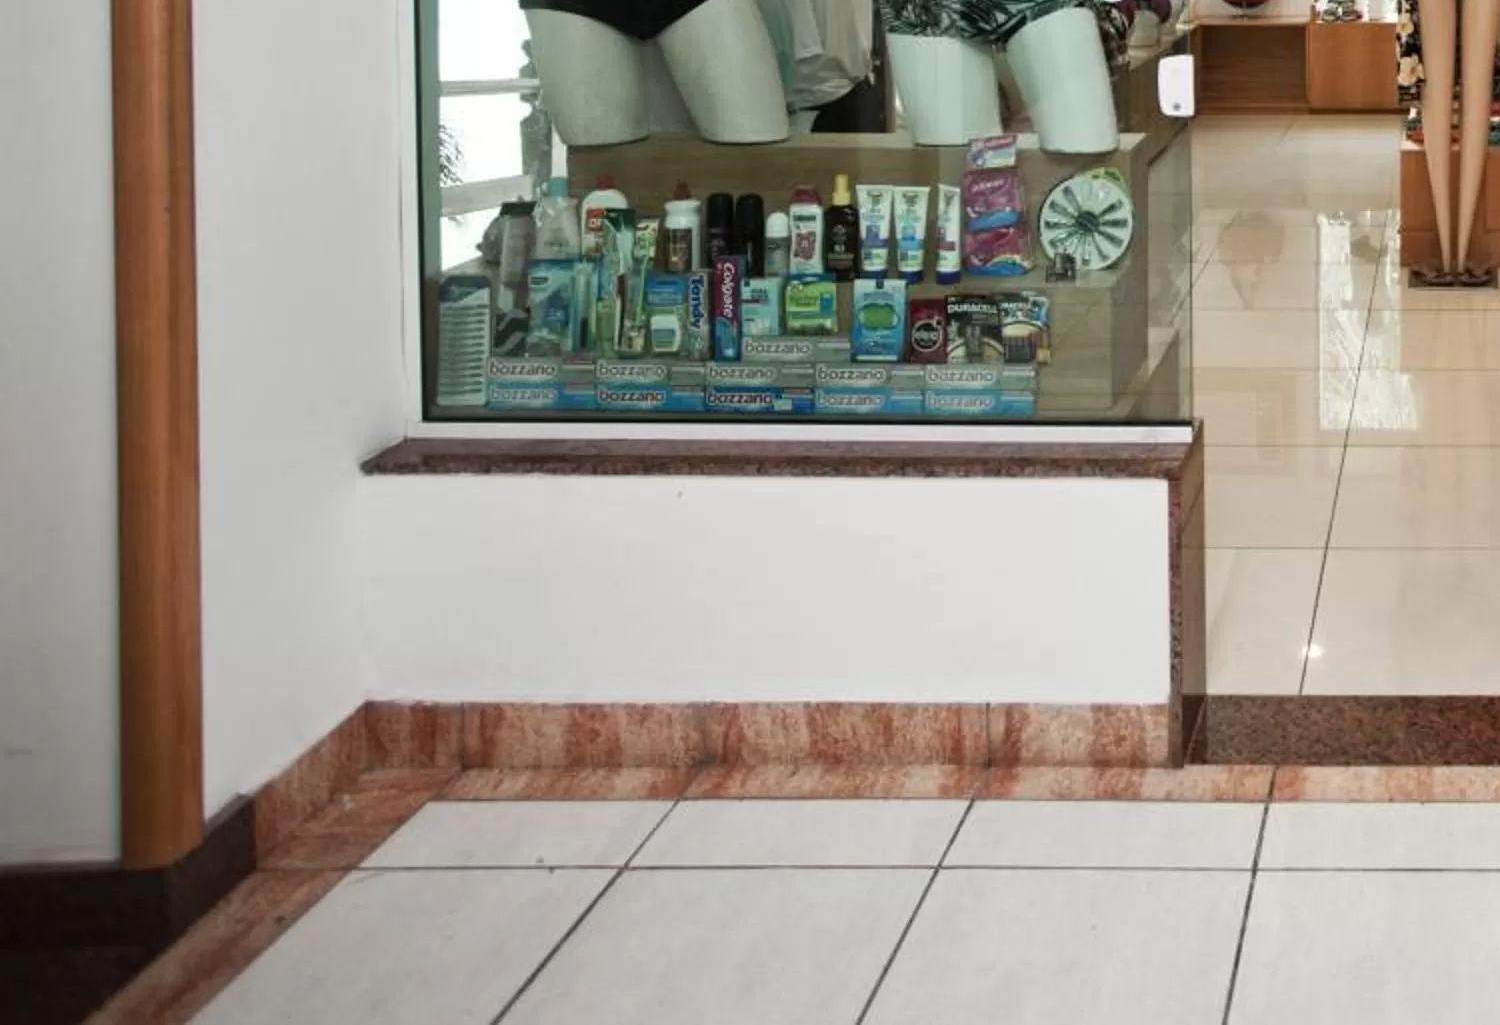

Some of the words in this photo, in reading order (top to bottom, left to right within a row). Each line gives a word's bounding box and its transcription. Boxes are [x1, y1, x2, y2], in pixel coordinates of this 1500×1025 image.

[721, 262, 735, 319] Colgate
[690, 275, 705, 329] Tandy
[947, 303, 998, 314] DURACELL
[745, 339, 811, 354] bozzano
[489, 360, 556, 377] bozzano
[597, 362, 666, 378] bozzano
[709, 365, 775, 380] bozzano
[819, 366, 884, 381] bozzano
[929, 366, 995, 382] bozzano
[491, 384, 558, 401] bozzano
[599, 386, 666, 403] bozzano
[708, 389, 774, 405] bozzano
[819, 391, 883, 407] bozzano
[929, 391, 993, 408] bozzano
